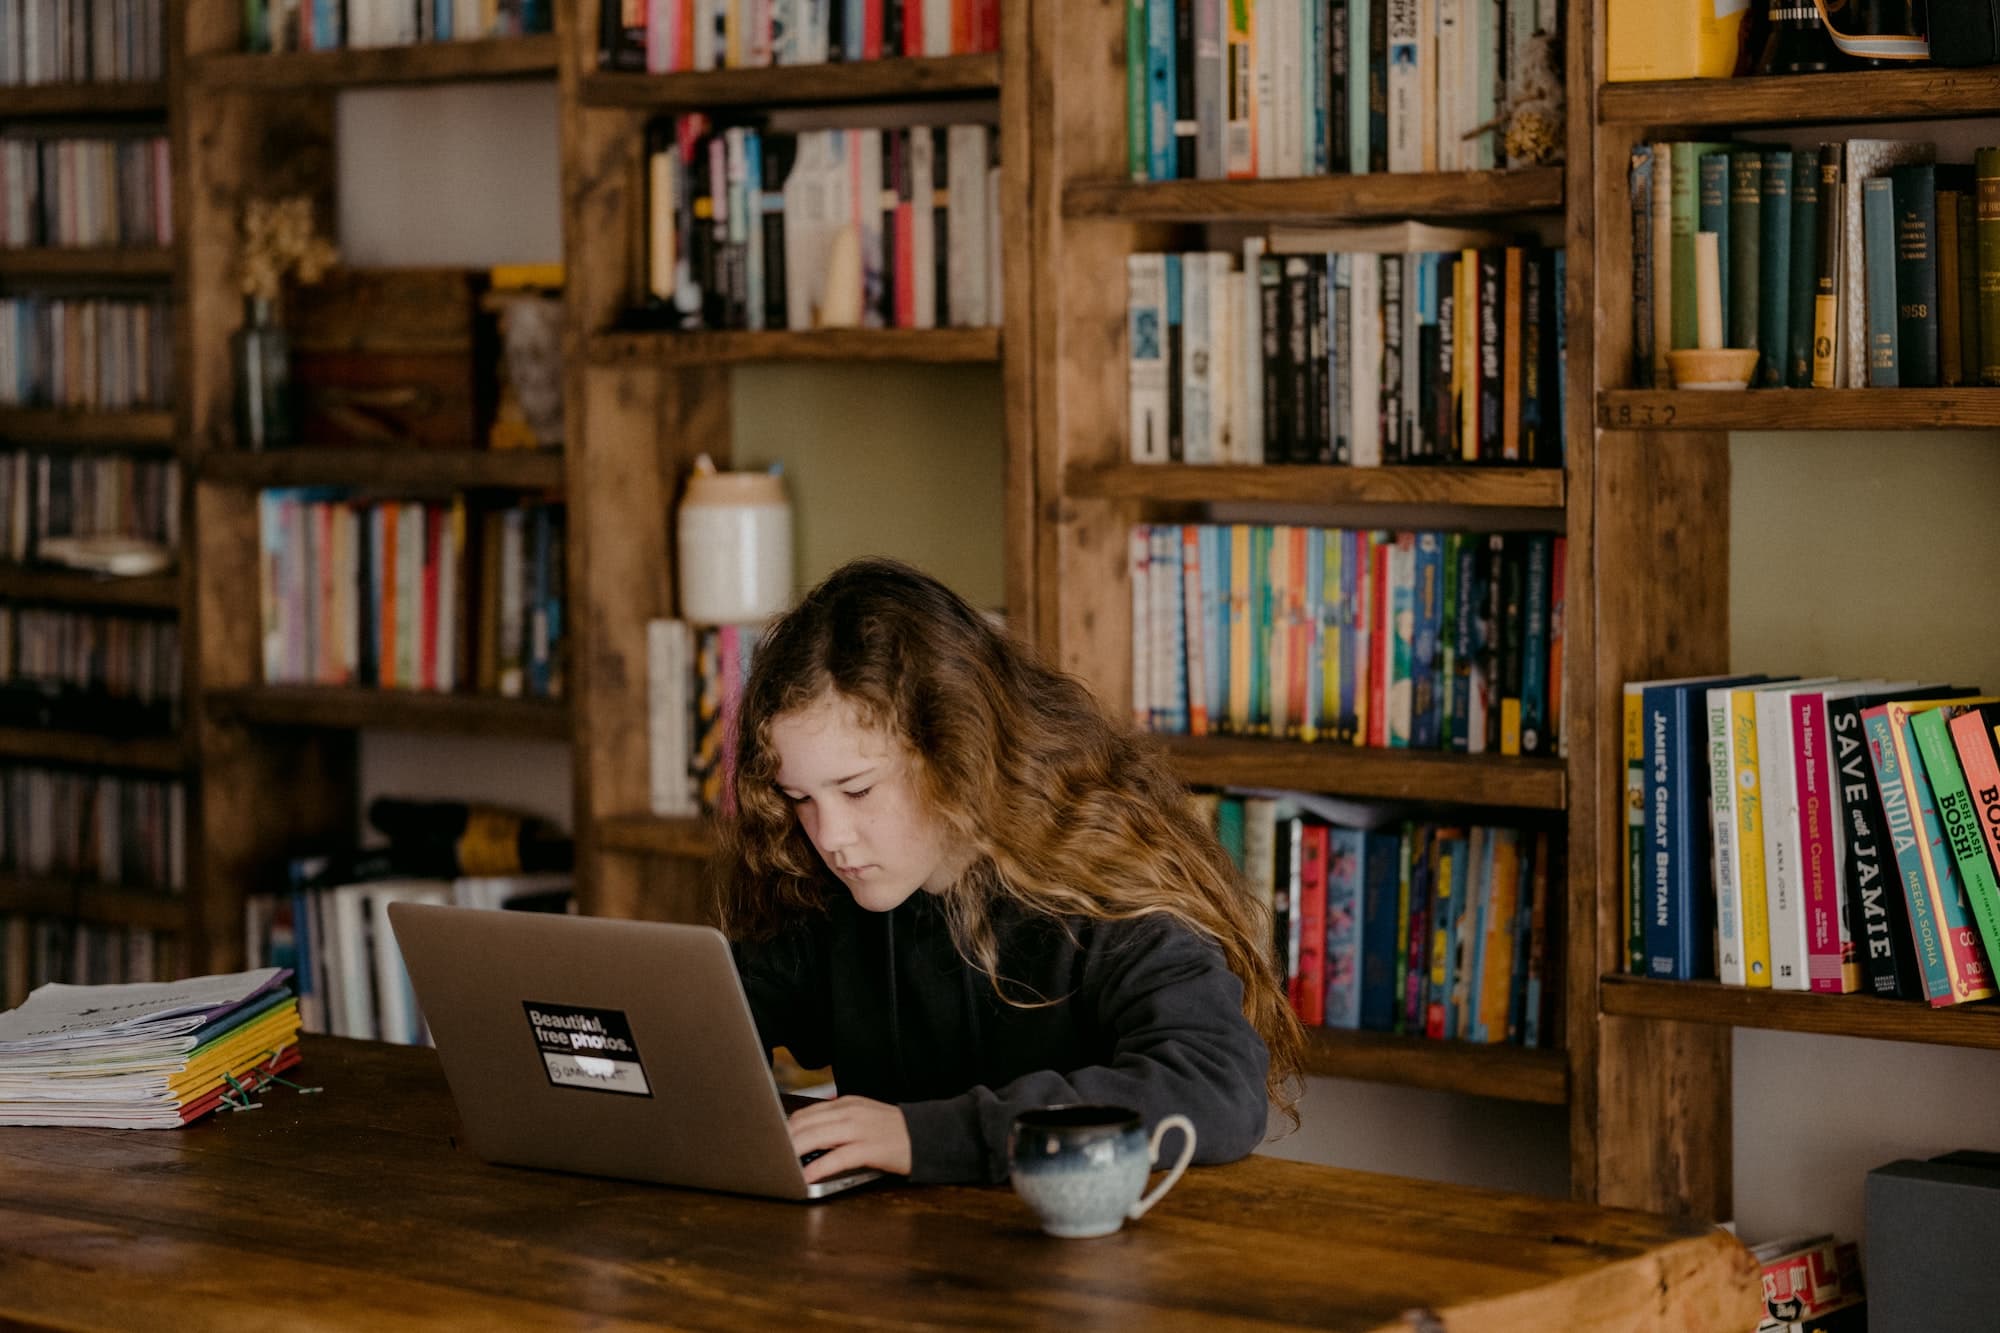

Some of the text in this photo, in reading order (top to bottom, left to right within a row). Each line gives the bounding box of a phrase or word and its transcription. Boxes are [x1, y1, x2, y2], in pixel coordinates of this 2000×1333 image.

[1902, 303, 1928, 319] 1958
[1711, 707, 1726, 736] TOM
[1802, 704, 1811, 726] The
[1802, 727, 1814, 757] Hairy
[1834, 712, 1868, 803] SAVE
[1874, 722, 1895, 774] MADE IN
[1712, 740, 1730, 813] KERRIDGE
[1653, 711, 1669, 927] JAMIE'S GREAT BRITAIN
[1717, 821, 1728, 845] LOSE
[1807, 797, 1819, 840] Great
[1852, 808, 1870, 838] with
[1881, 778, 1916, 855] INDIA
[1939, 792, 1974, 863] BOSH!
[1955, 789, 1984, 856] BISH BASH
[1719, 848, 1731, 886] WEIGHT
[1810, 842, 1823, 902] Curries
[1975, 873, 1986, 896] HENRY
[1777, 877, 1786, 911] JONES
[1854, 840, 1891, 959] JAMIE
[1907, 869, 1927, 917] MEERA
[1920, 918, 1939, 968] SODHA
[528, 1010, 608, 1035] Beautiful,
[534, 1026, 633, 1052] free photos.
